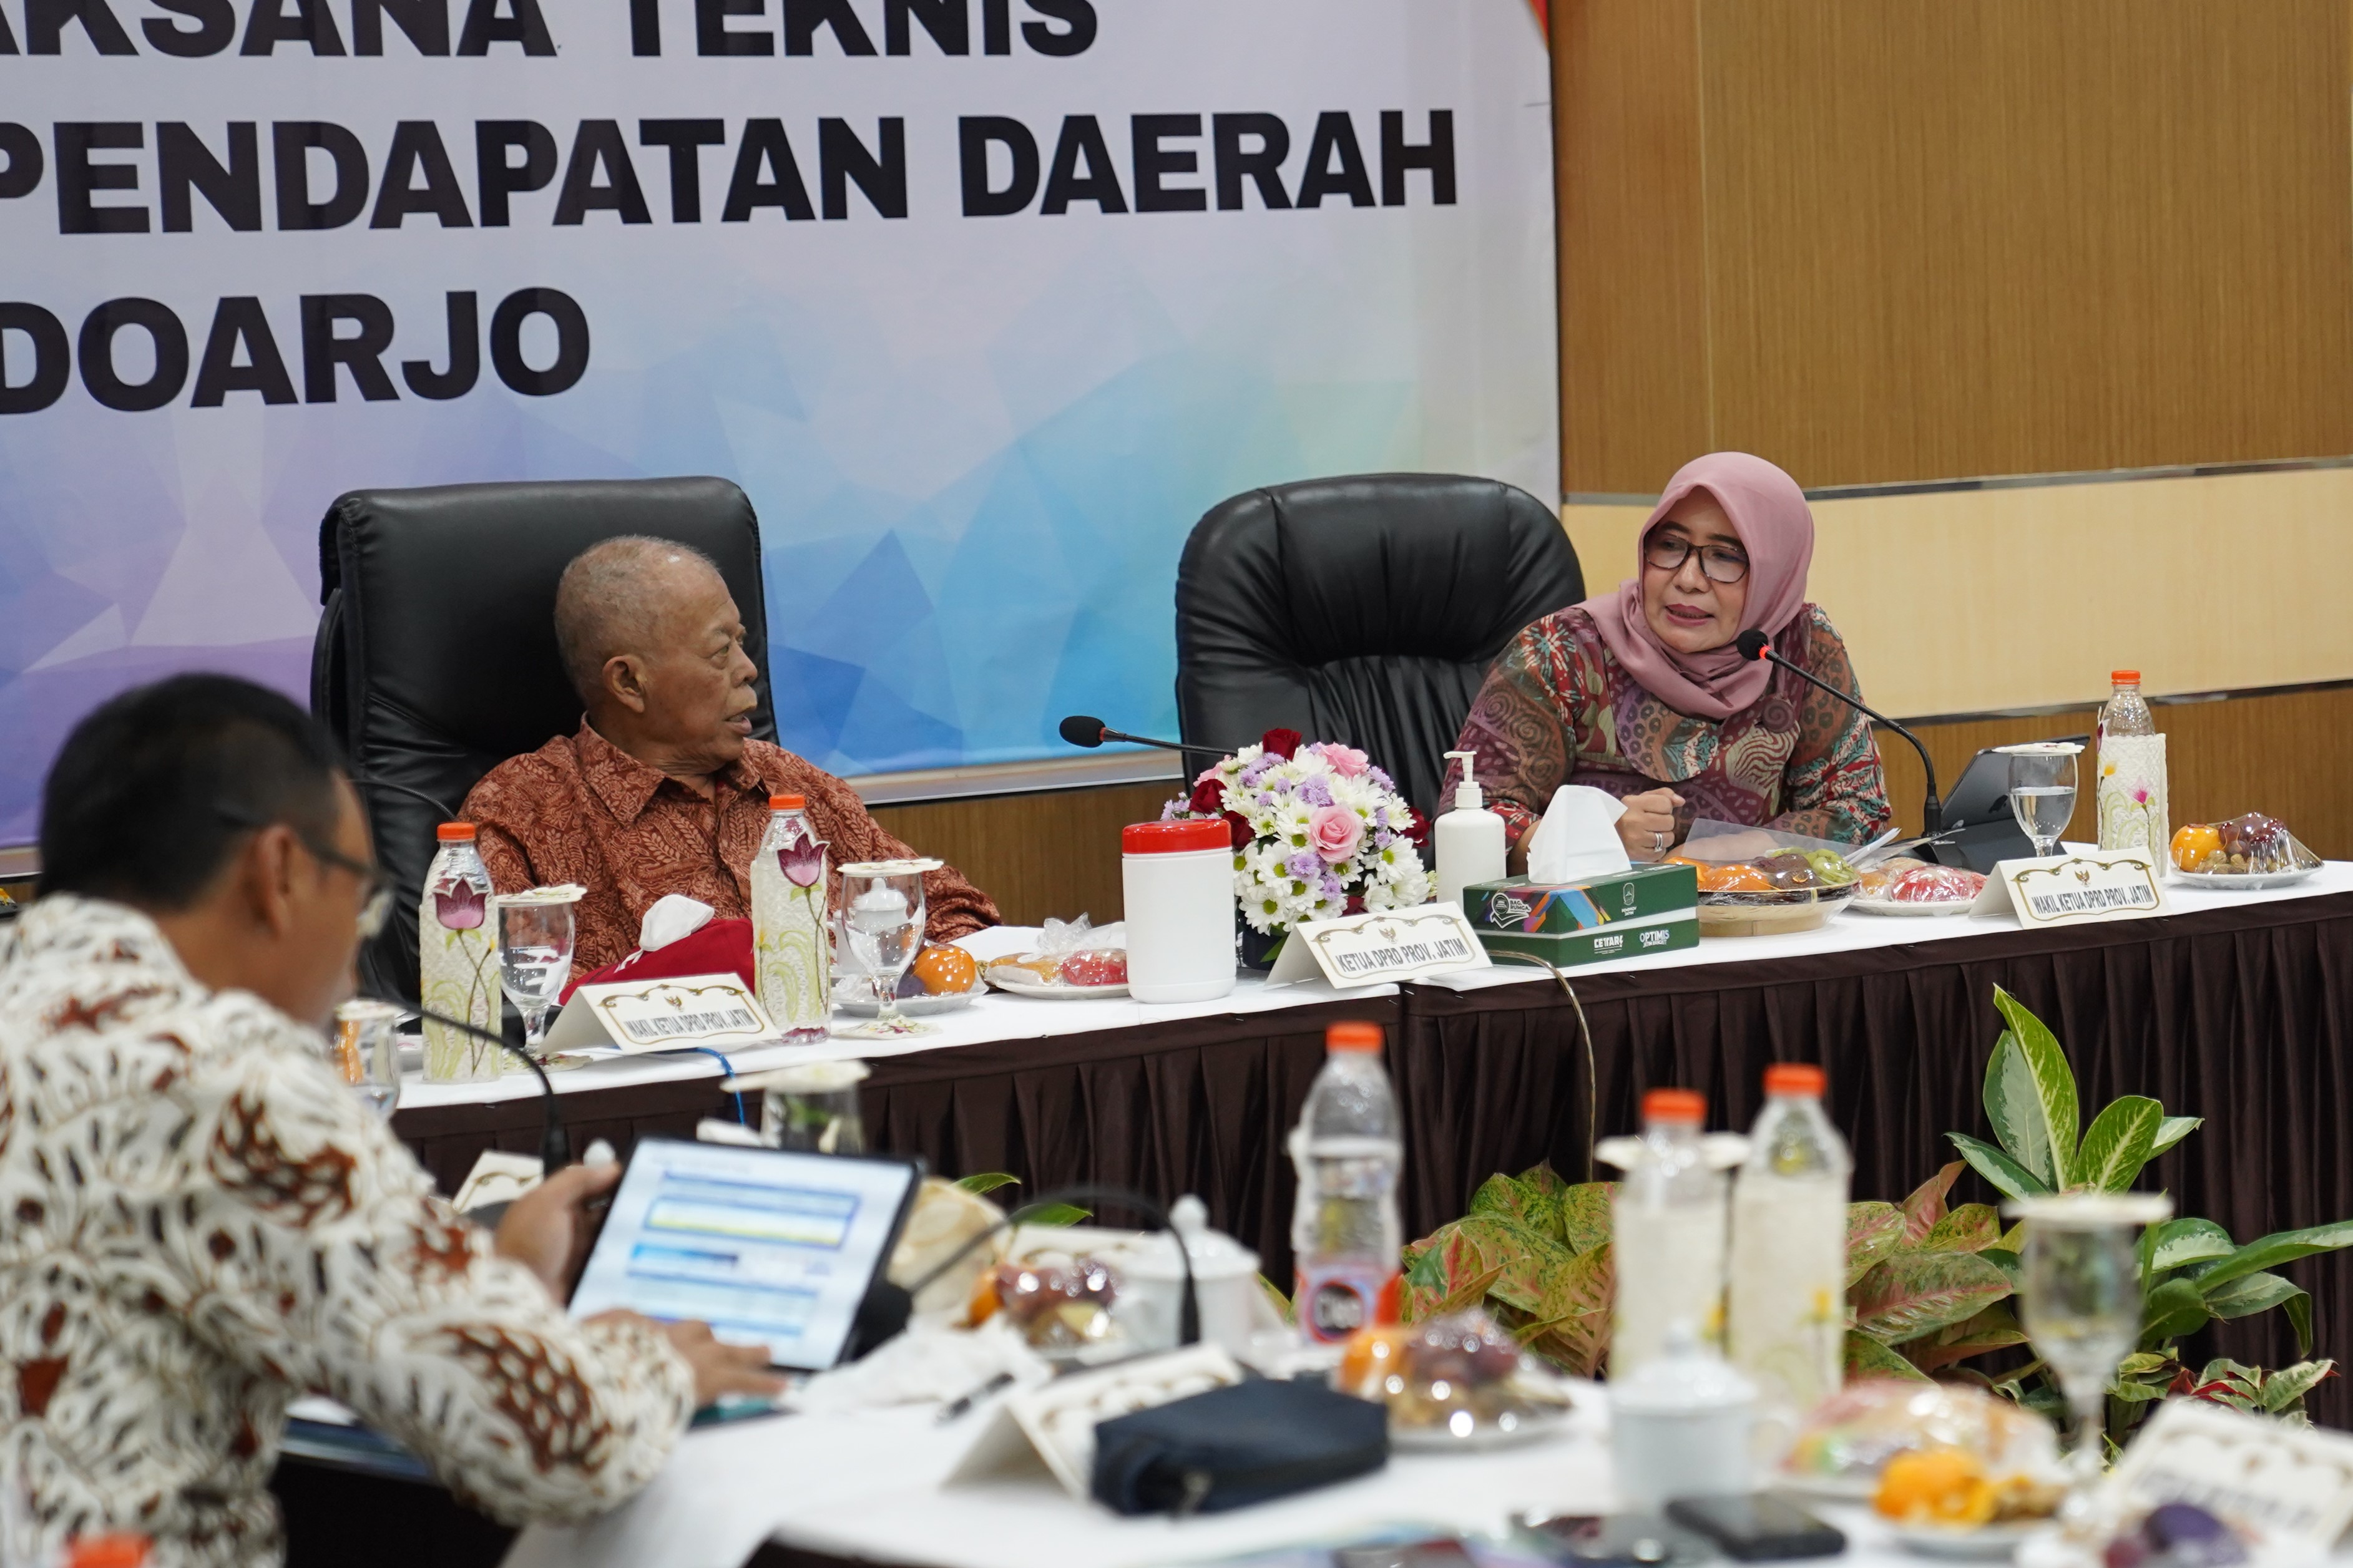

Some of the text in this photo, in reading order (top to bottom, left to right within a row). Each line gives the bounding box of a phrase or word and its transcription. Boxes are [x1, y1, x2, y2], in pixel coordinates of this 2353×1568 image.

[0, 0, 557, 57] KSANA
[958, 109, 1457, 217] DAERAH
[0, 287, 590, 415] DOARJO
[2032, 884, 2154, 914] WAKIL KETUA DPRD PROV. JATIM
[1639, 930, 1670, 943] OPTIMIS
[1336, 938, 1468, 972] KETUA DPRD PROV. JATIM
[624, 1019, 658, 1038] WAKIL
[650, 1016, 687, 1036] KETUA
[678, 1013, 708, 1033] DPRD
[725, 1008, 756, 1027] JATIM
